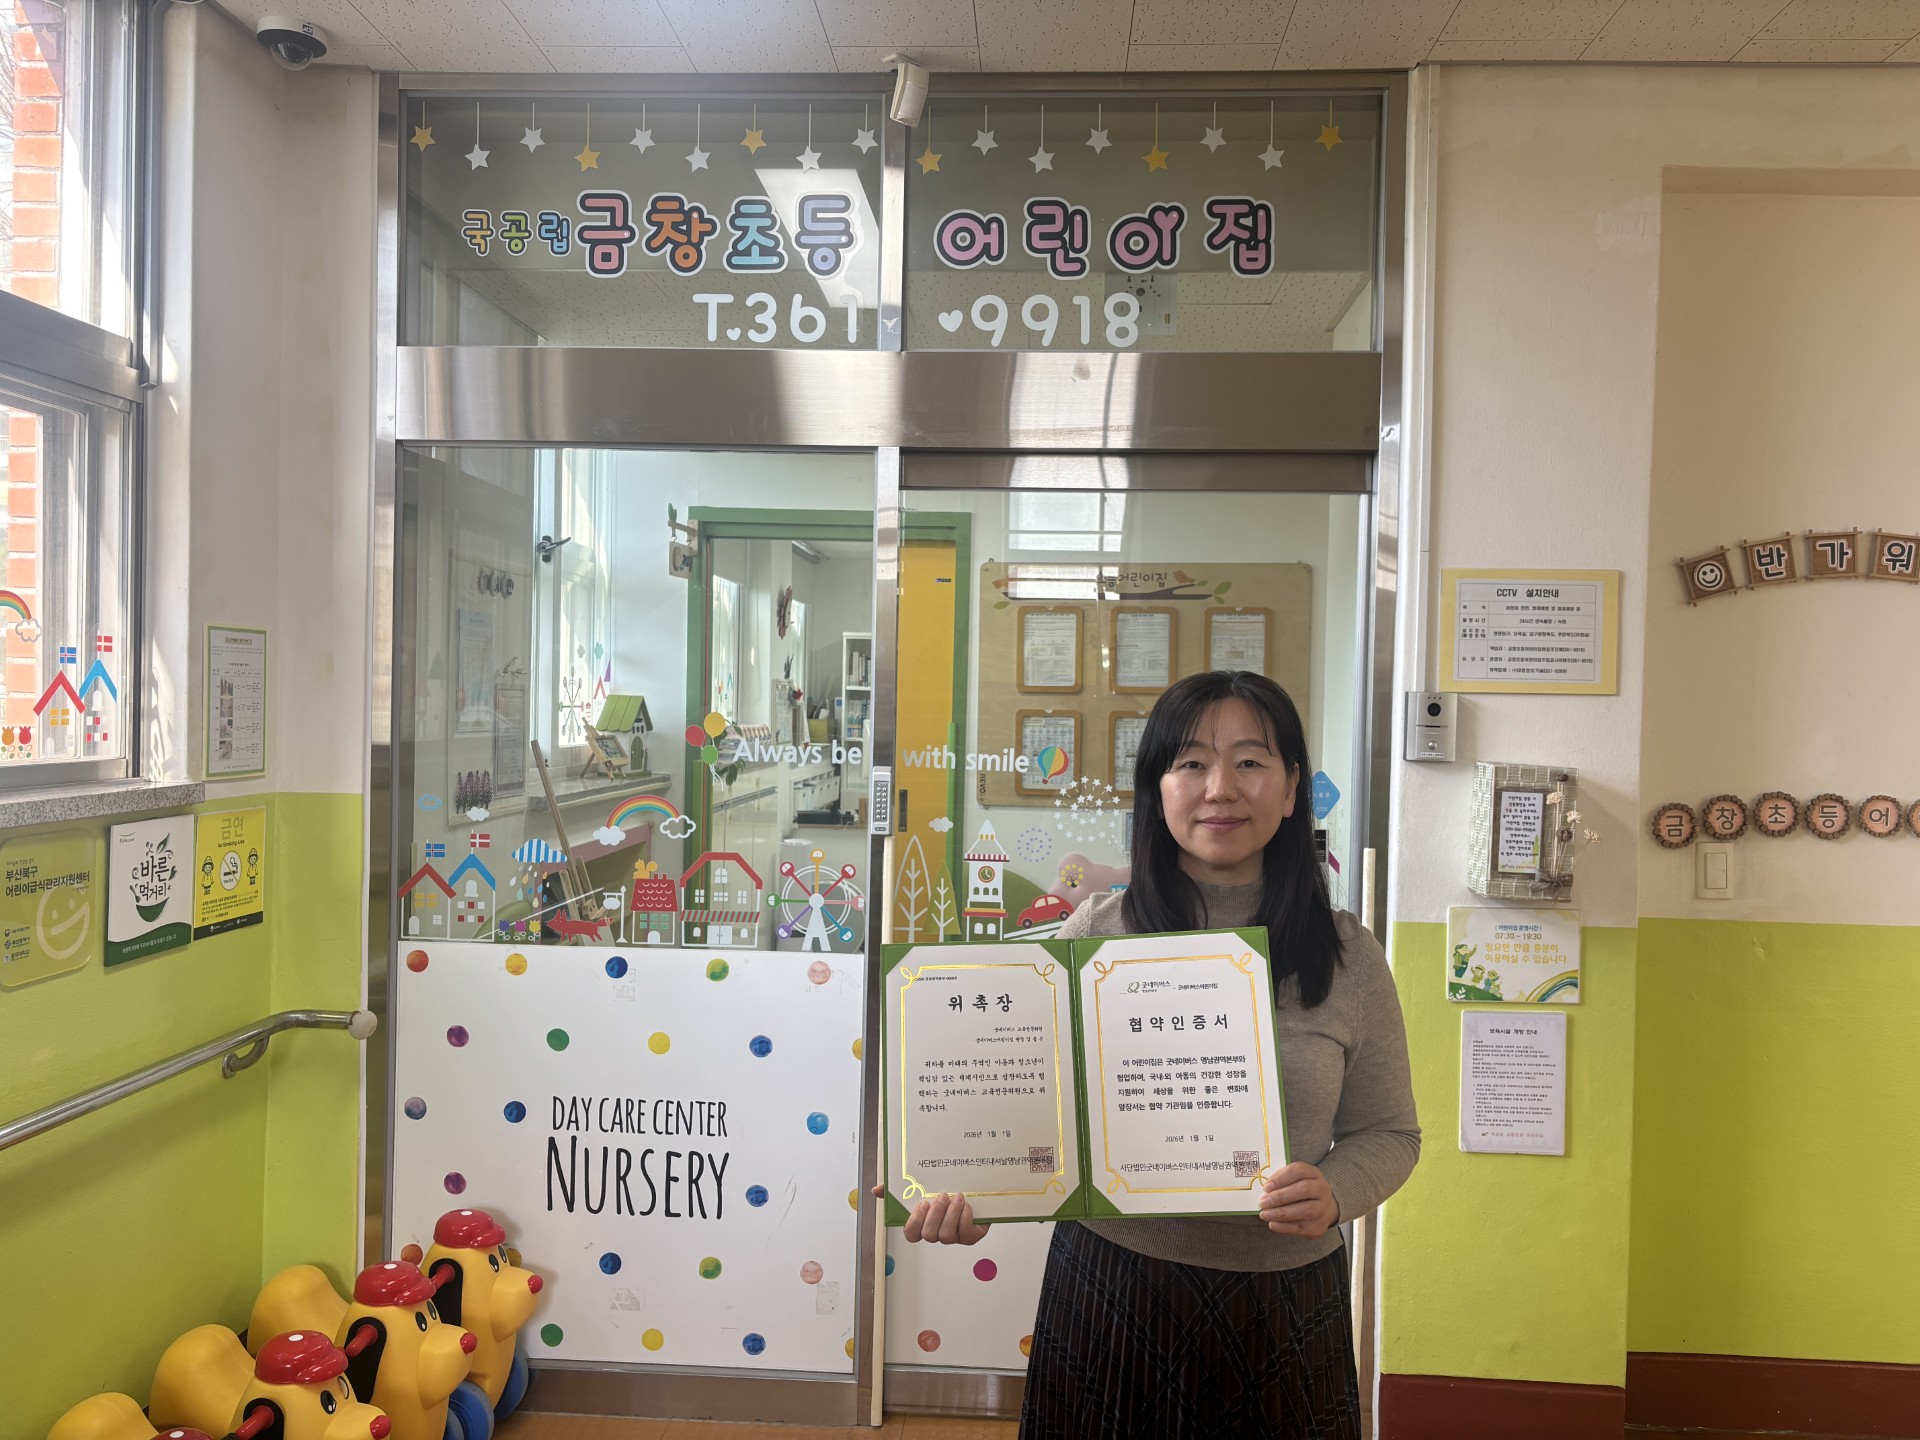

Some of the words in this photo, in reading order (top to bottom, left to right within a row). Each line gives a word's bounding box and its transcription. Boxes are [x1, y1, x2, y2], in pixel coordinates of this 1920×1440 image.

[462, 208, 571, 257] 국공립
[575, 190, 862, 279] 금창초등
[970, 292, 1140, 348] 9918
[1496, 588, 1518, 598] CCTV
[1525, 588, 1560, 599] 설치안내
[731, 739, 823, 769] Always
[831, 738, 863, 766] be
[901, 744, 957, 771] with
[965, 747, 1029, 774] smile
[220, 815, 244, 840] 금연
[5, 866, 38, 883] 부산북구
[140, 855, 170, 883] 바른
[5, 871, 90, 898] 어린이급식관리지원센터
[139, 881, 167, 901] 먹거리
[1494, 932, 1515, 940] 07:30
[1522, 932, 1542, 941] 19:30
[1485, 942, 1510, 953] 필요한
[1513, 942, 1530, 953] 만큼
[1484, 953, 1519, 964] 이용하실
[1521, 954, 1530, 964] 수
[947, 993, 1013, 1013] 위촉장
[1128, 1013, 1228, 1033] 협약인증서
[924, 1060, 945, 1068] 귀하를
[971, 1058, 991, 1067] 주역인
[1017, 1057, 1044, 1066] 청소년이
[1122, 1059, 1130, 1067] 이
[1131, 1058, 1164, 1067] 어린이집은
[1165, 1057, 1198, 1066] 굿네이버스
[941, 1074, 955, 1082] 있는
[1175, 1071, 1197, 1080] 아동의
[1200, 1070, 1222, 1080] 건강한
[1225, 1069, 1247, 1079] 성장을
[943, 1088, 977, 1097] 굿네이버스
[1117, 1088, 1145, 1097] 지원하여
[1153, 1087, 1174, 1096] 세상을
[1181, 1086, 1197, 1095] 위한
[1204, 1085, 1218, 1094] 좋은
[1118, 1102, 1146, 1111] 앞장서는
[1148, 1102, 1163, 1111] 협약
[1165, 1101, 1194, 1110] 기관임을
[1196, 1099, 1234, 1109] 인증합니다.
[552, 1096, 593, 1132] DAY
[598, 1097, 647, 1135] CARE
[652, 1099, 729, 1138] CENTER
[963, 1130, 982, 1138] 2026년
[987, 1130, 997, 1138] 1월
[1002, 1129, 1011, 1138] 1일
[1165, 1135, 1184, 1143] 2026년
[1189, 1134, 1199, 1142] 1월
[1204, 1134, 1214, 1142] 1일
[547, 1135, 730, 1220] NURSERY
